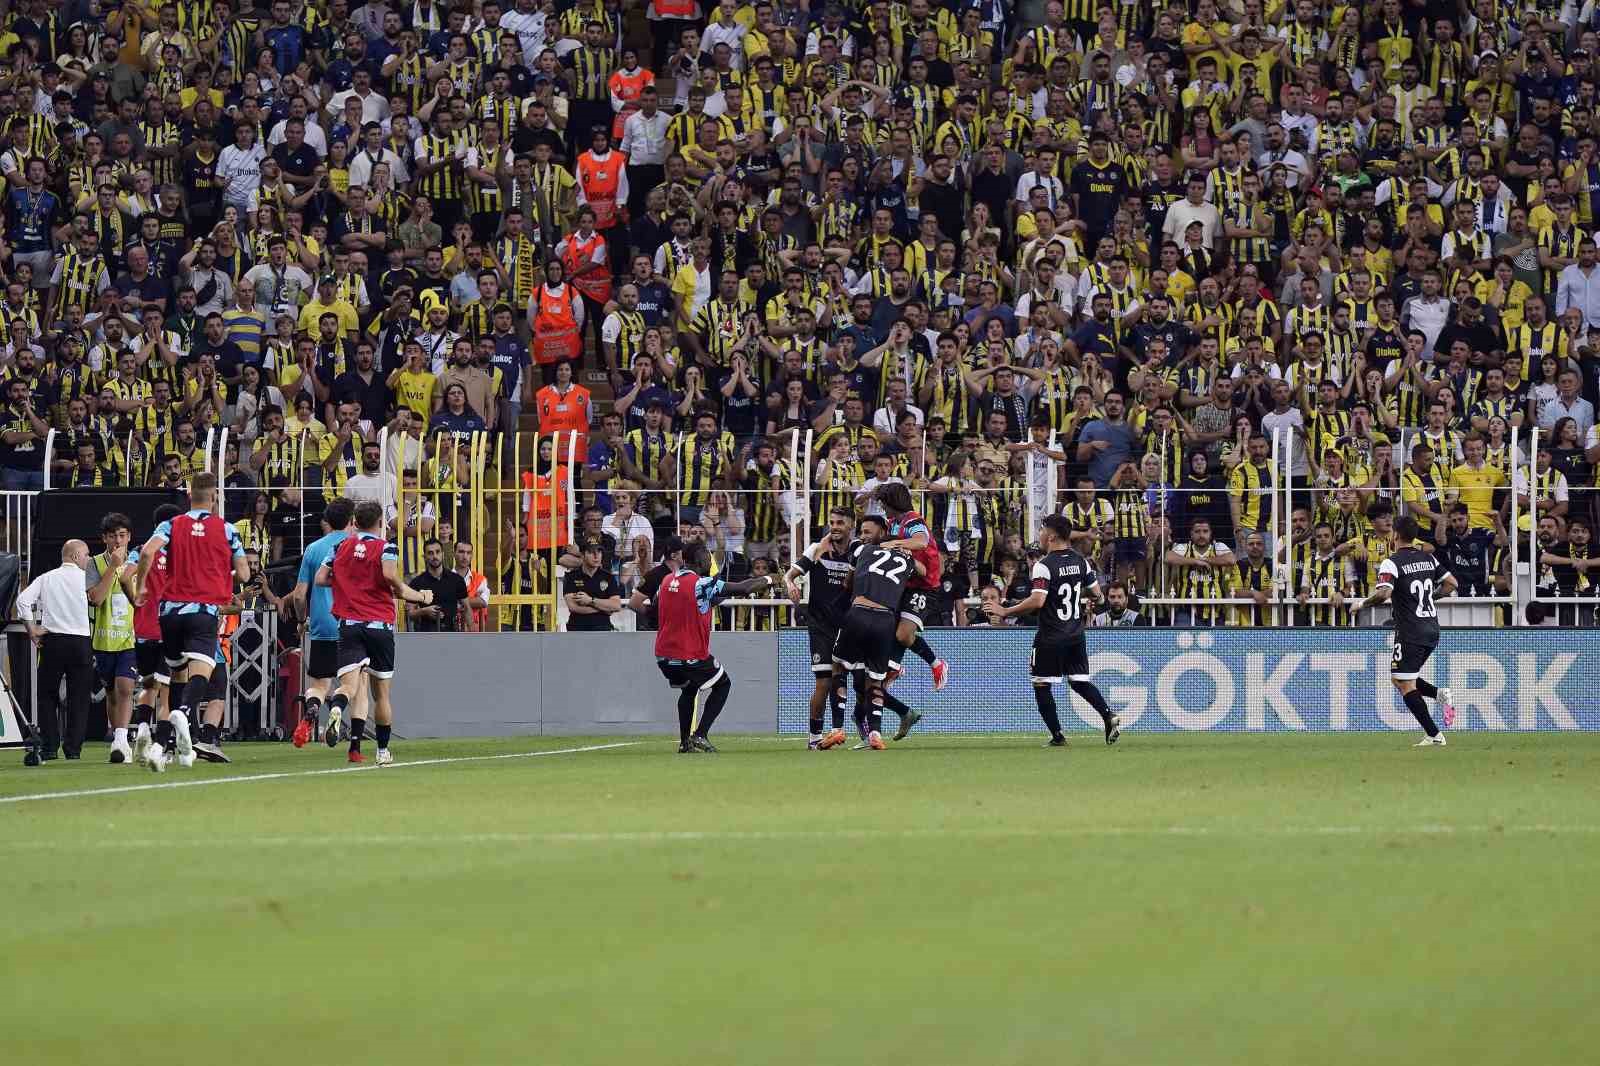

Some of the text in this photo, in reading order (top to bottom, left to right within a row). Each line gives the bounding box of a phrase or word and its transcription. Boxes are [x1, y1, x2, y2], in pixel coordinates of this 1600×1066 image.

[868, 550, 908, 585] 22
[1056, 581, 1082, 621] 31
[1410, 578, 1437, 618] 23
